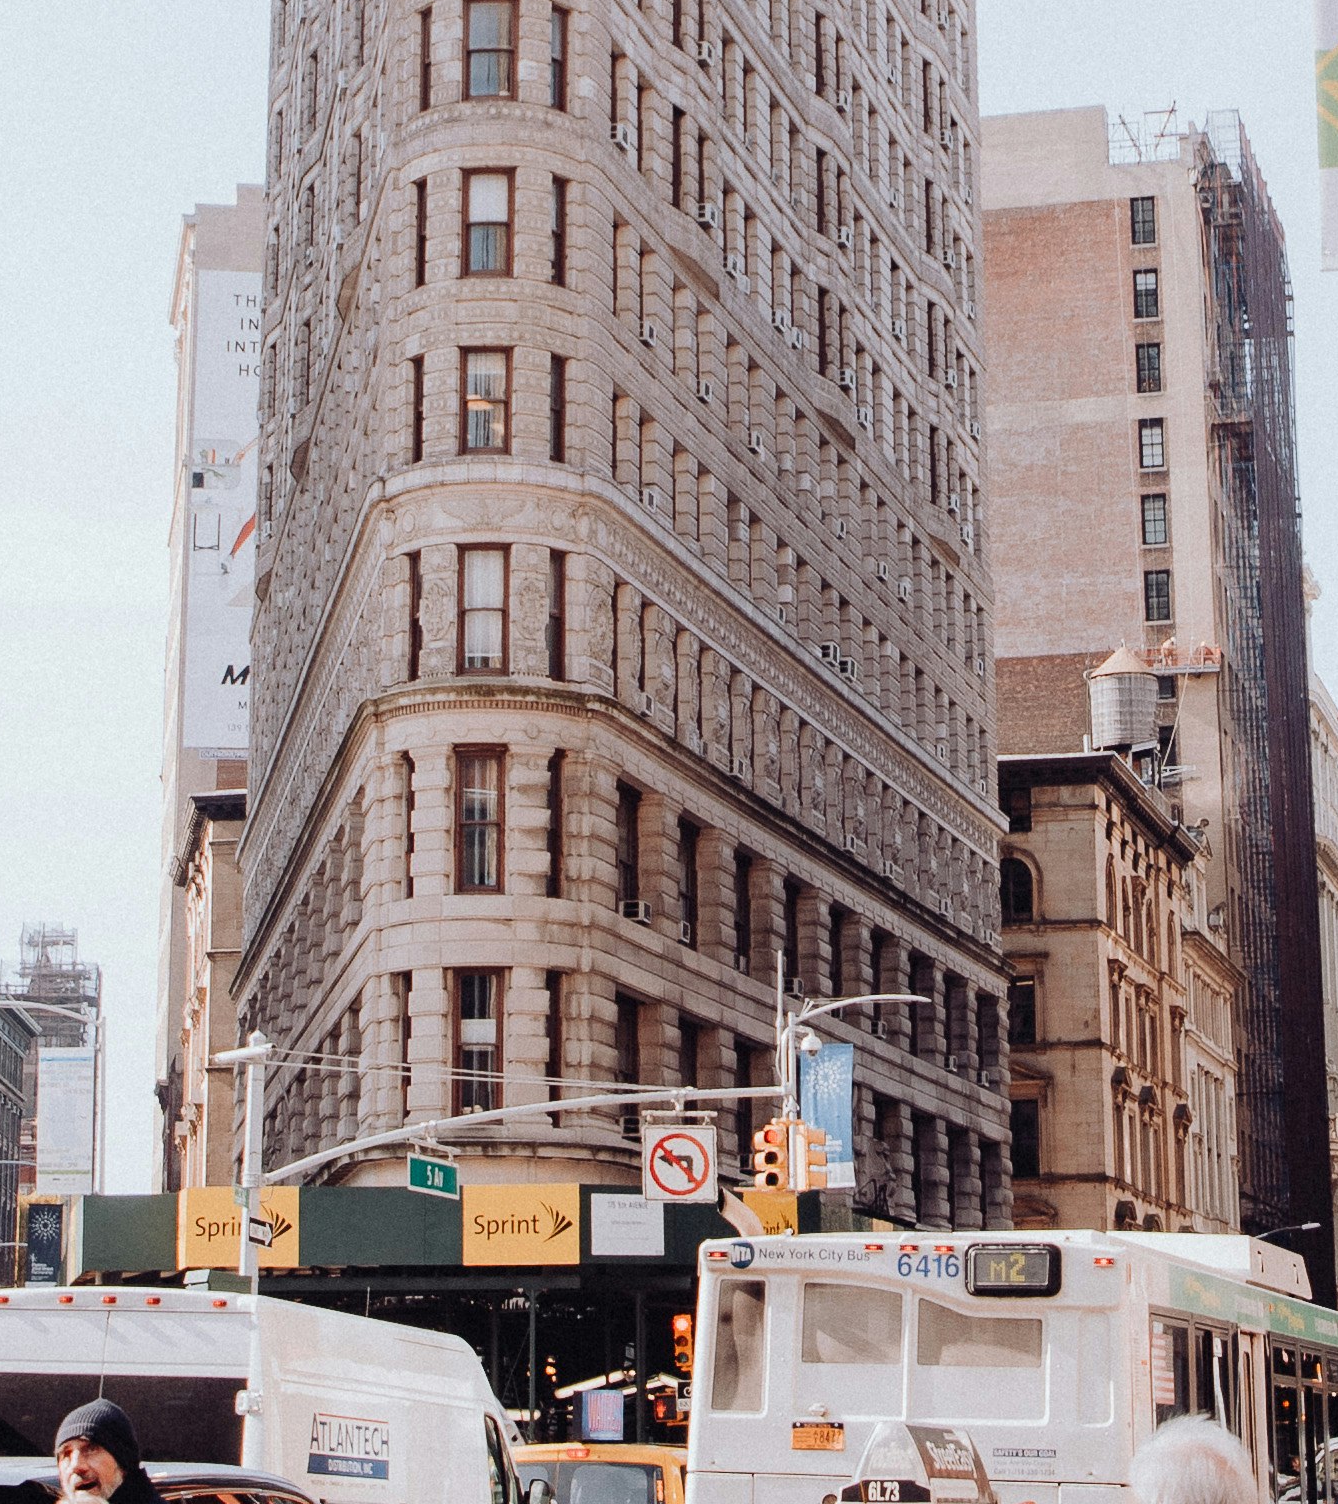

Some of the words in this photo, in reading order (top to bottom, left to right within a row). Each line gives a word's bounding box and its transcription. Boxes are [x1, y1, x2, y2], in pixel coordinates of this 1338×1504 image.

[426, 1165, 433, 1186] 5
[434, 1167, 444, 1188] Av
[474, 1214, 540, 1240] Sprint
[759, 1248, 785, 1259] New
[788, 1248, 815, 1260] York
[818, 1248, 843, 1263] City
[847, 1250, 871, 1261] Bus
[897, 1253, 960, 1278] 6416
[989, 1254, 1026, 1282] M2
[310, 1412, 390, 1458] ATLANTECH
[867, 1481, 900, 1501] 6L73
